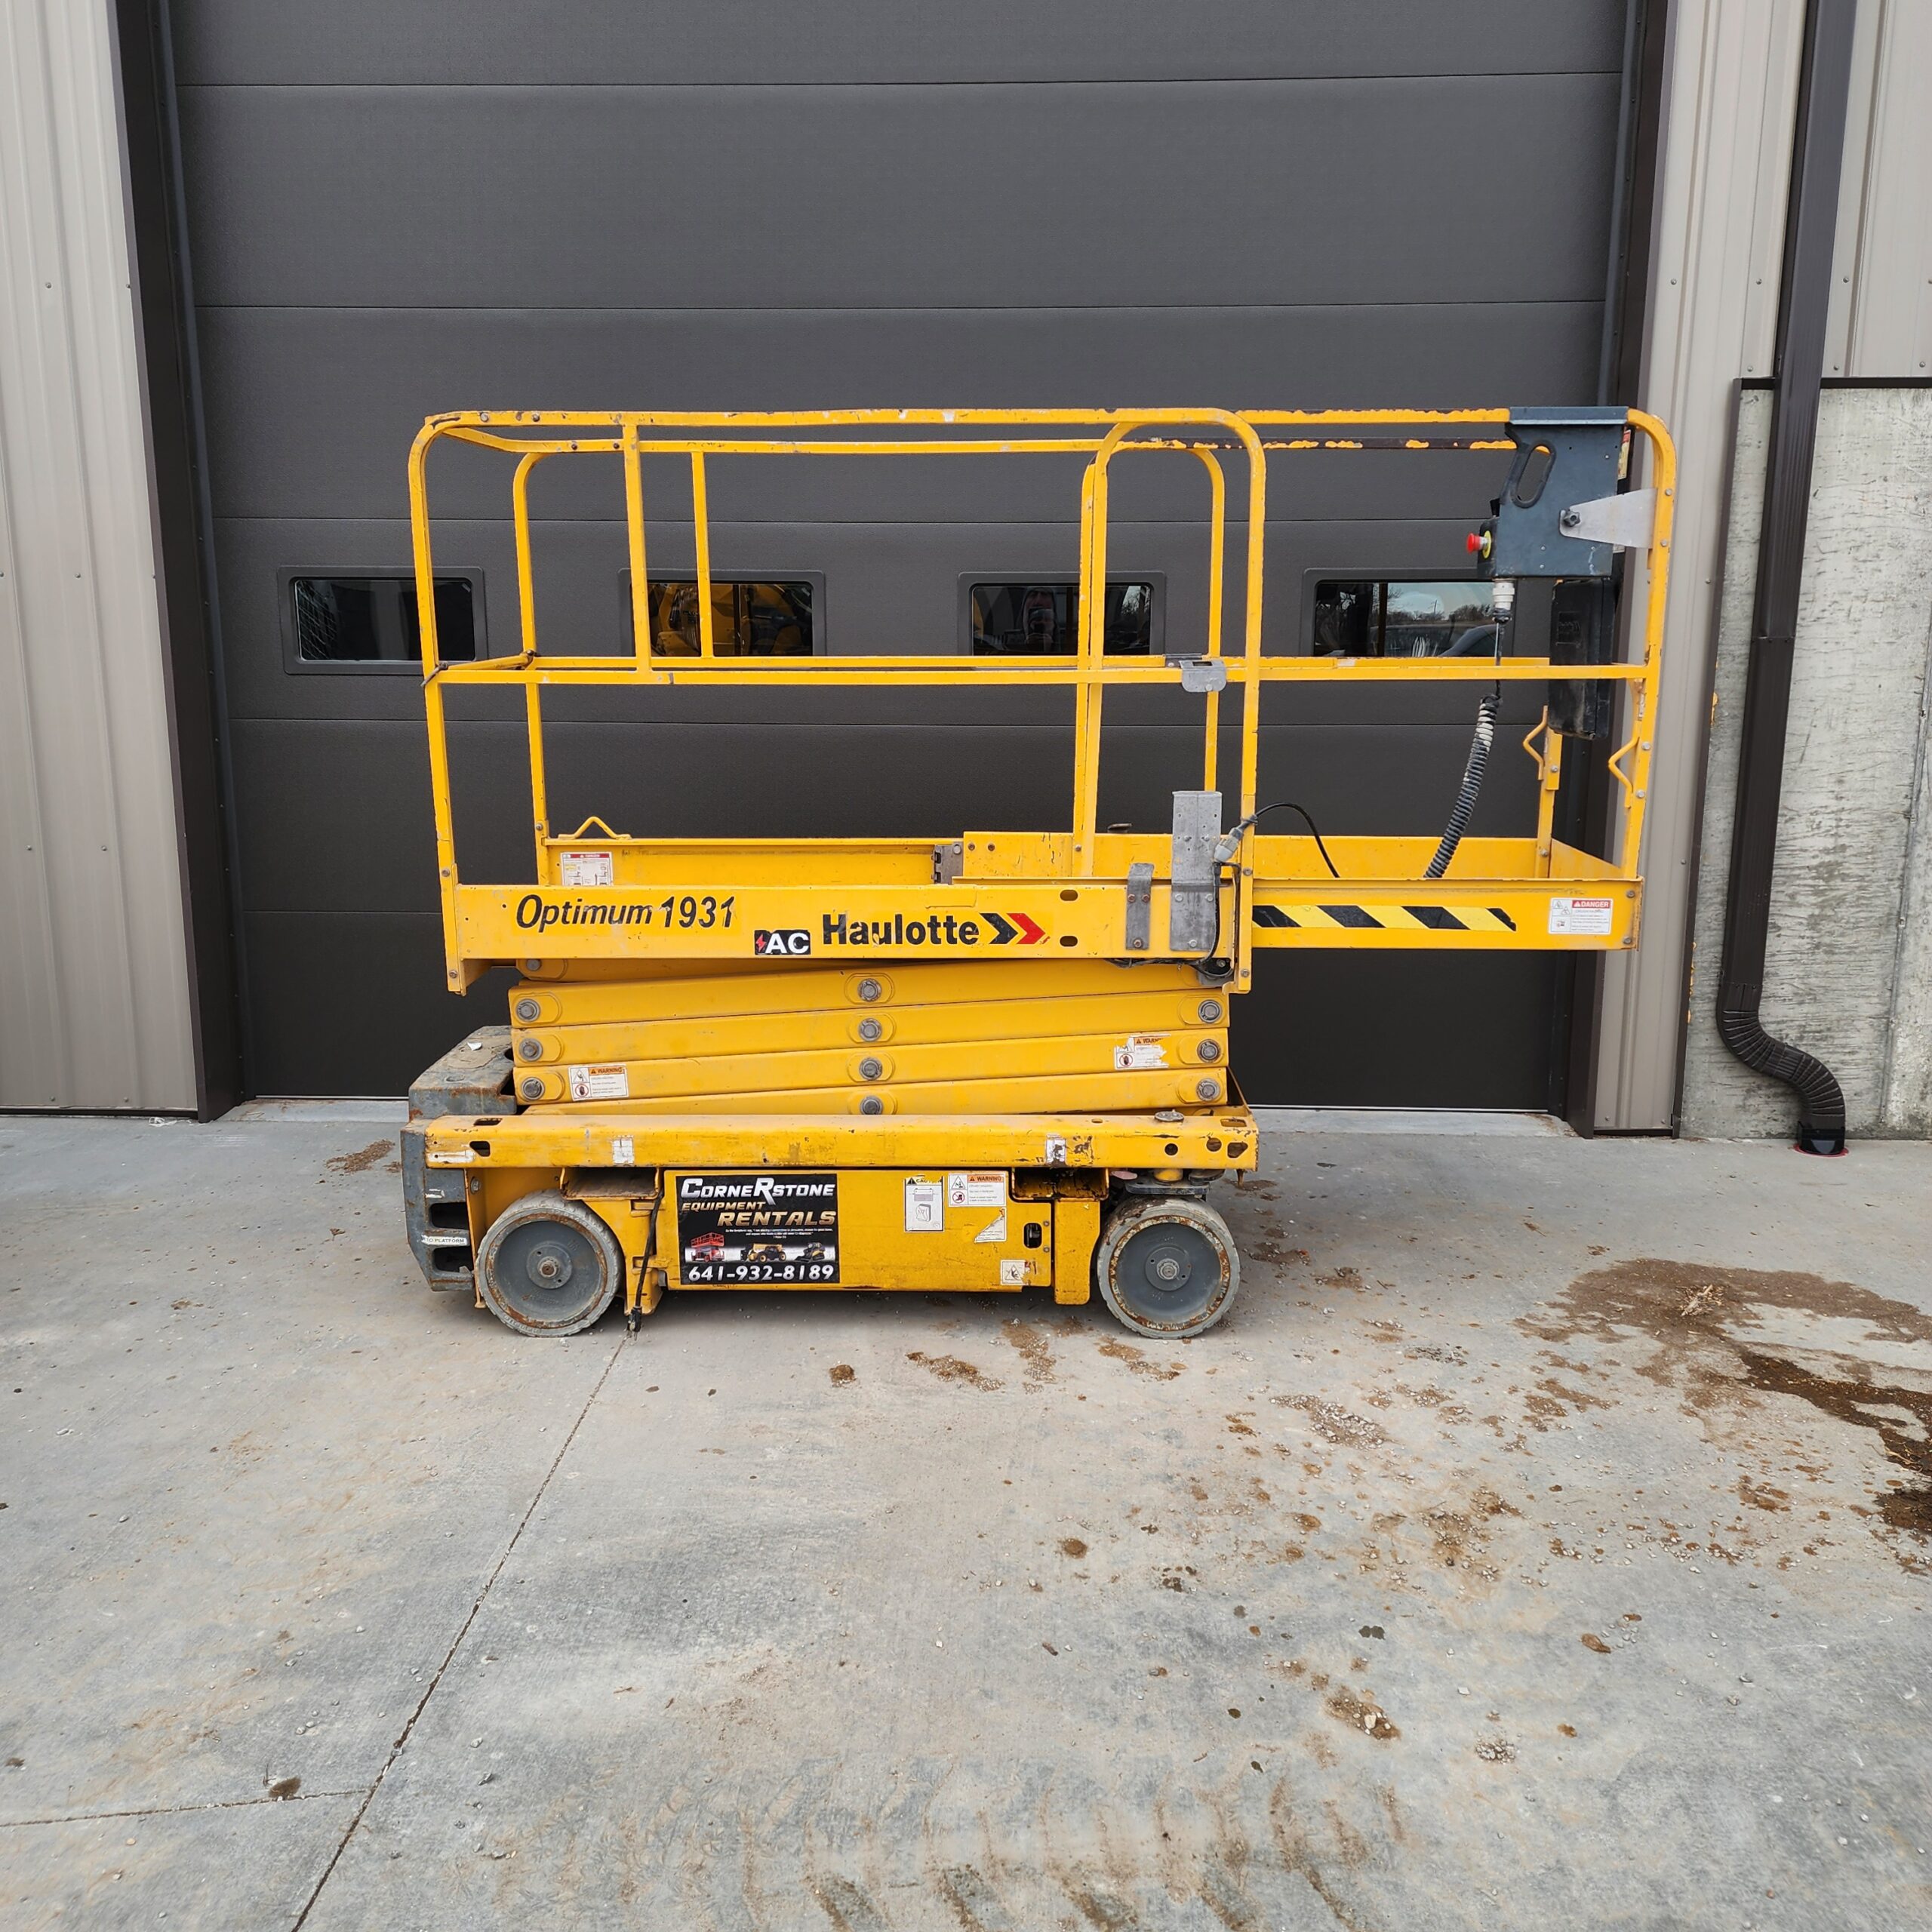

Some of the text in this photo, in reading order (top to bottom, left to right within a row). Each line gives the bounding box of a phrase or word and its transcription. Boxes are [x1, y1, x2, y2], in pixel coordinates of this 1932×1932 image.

[516, 894, 735, 934] Optimum 1931
[823, 913, 980, 945] Haulotte
[765, 932, 810, 954] AC
[681, 1201, 766, 1211] EQUIPMENT
[717, 1211, 836, 1226] RENTALS
[688, 1265, 834, 1281] 641-932-8189
